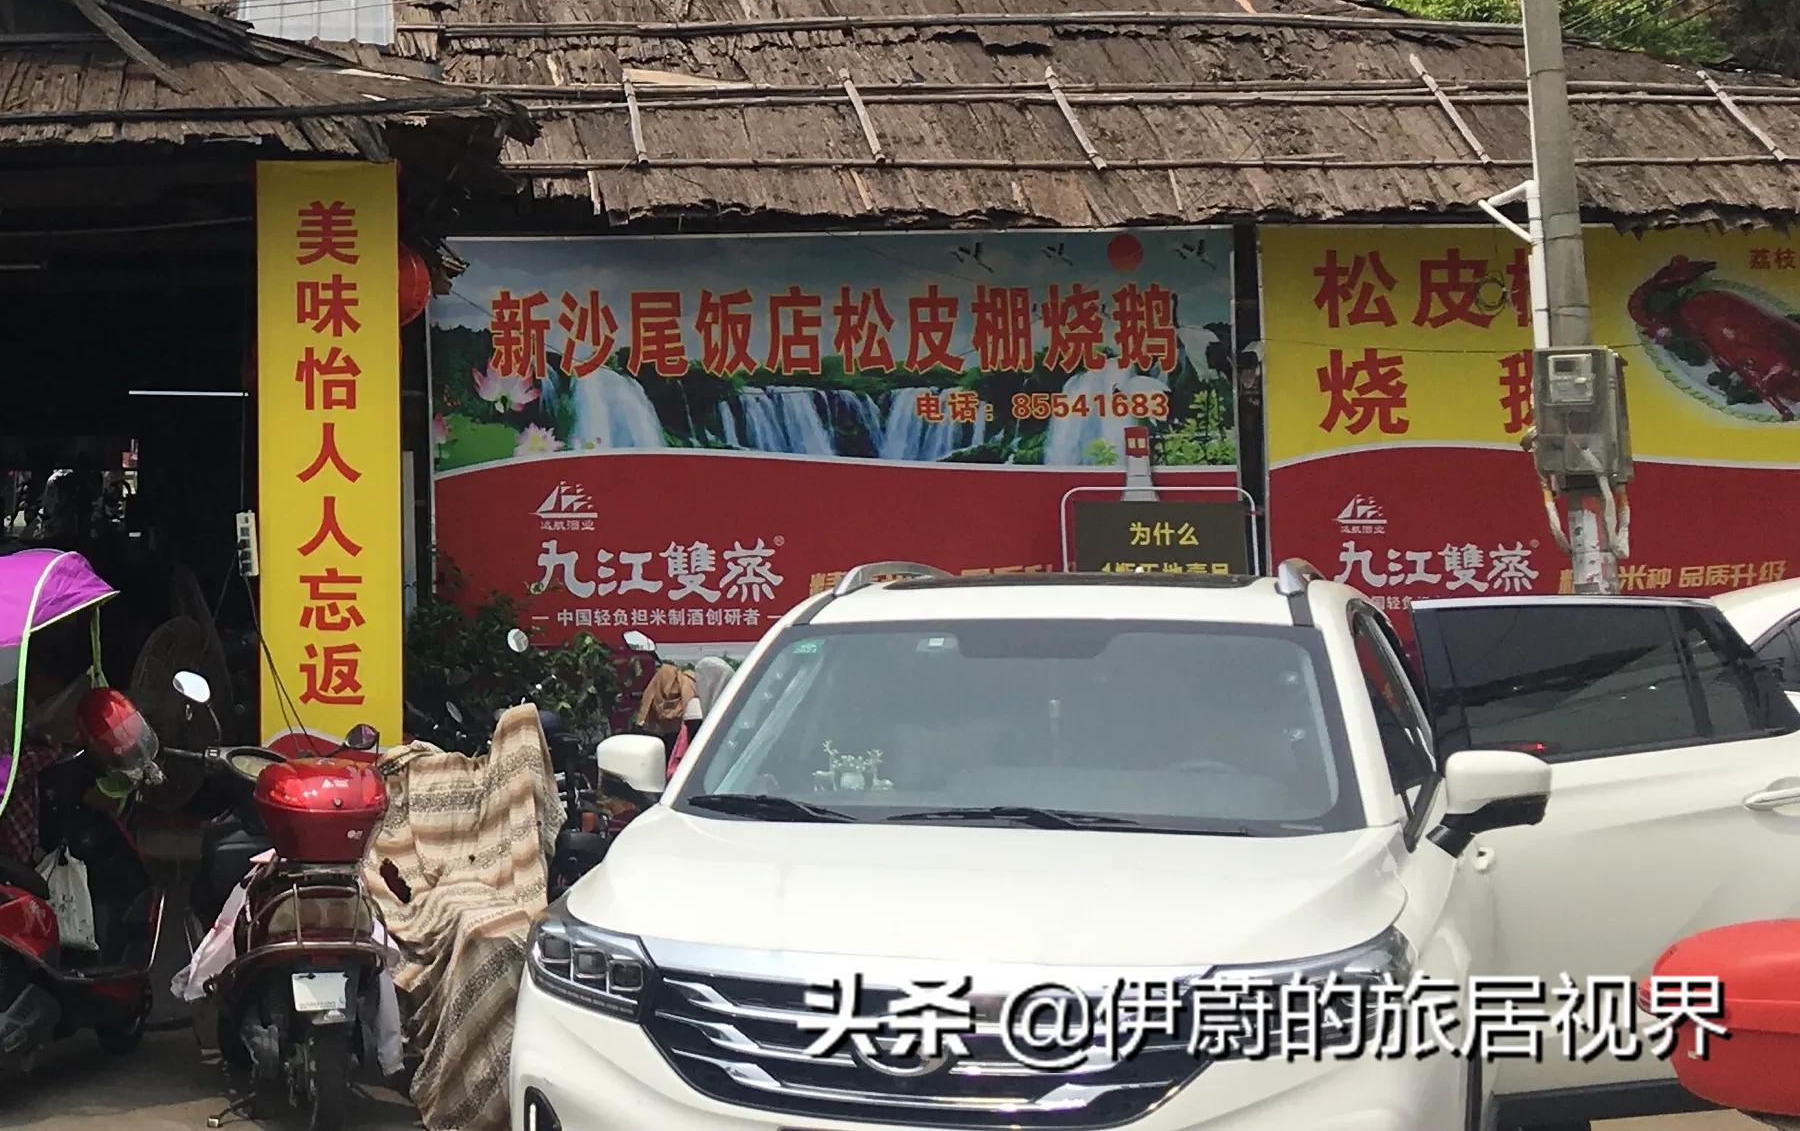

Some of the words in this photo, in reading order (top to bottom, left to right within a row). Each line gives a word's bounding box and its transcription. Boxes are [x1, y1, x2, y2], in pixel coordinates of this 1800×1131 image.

[490, 282, 1178, 377] 新沙尾饭店松皮棚烧鹅
[1314, 248, 1534, 330] 松皮
[294, 201, 366, 706] 美味怡人人忘返
[1129, 521, 1199, 546] 为什么
[1678, 559, 1788, 589] 品质升级
